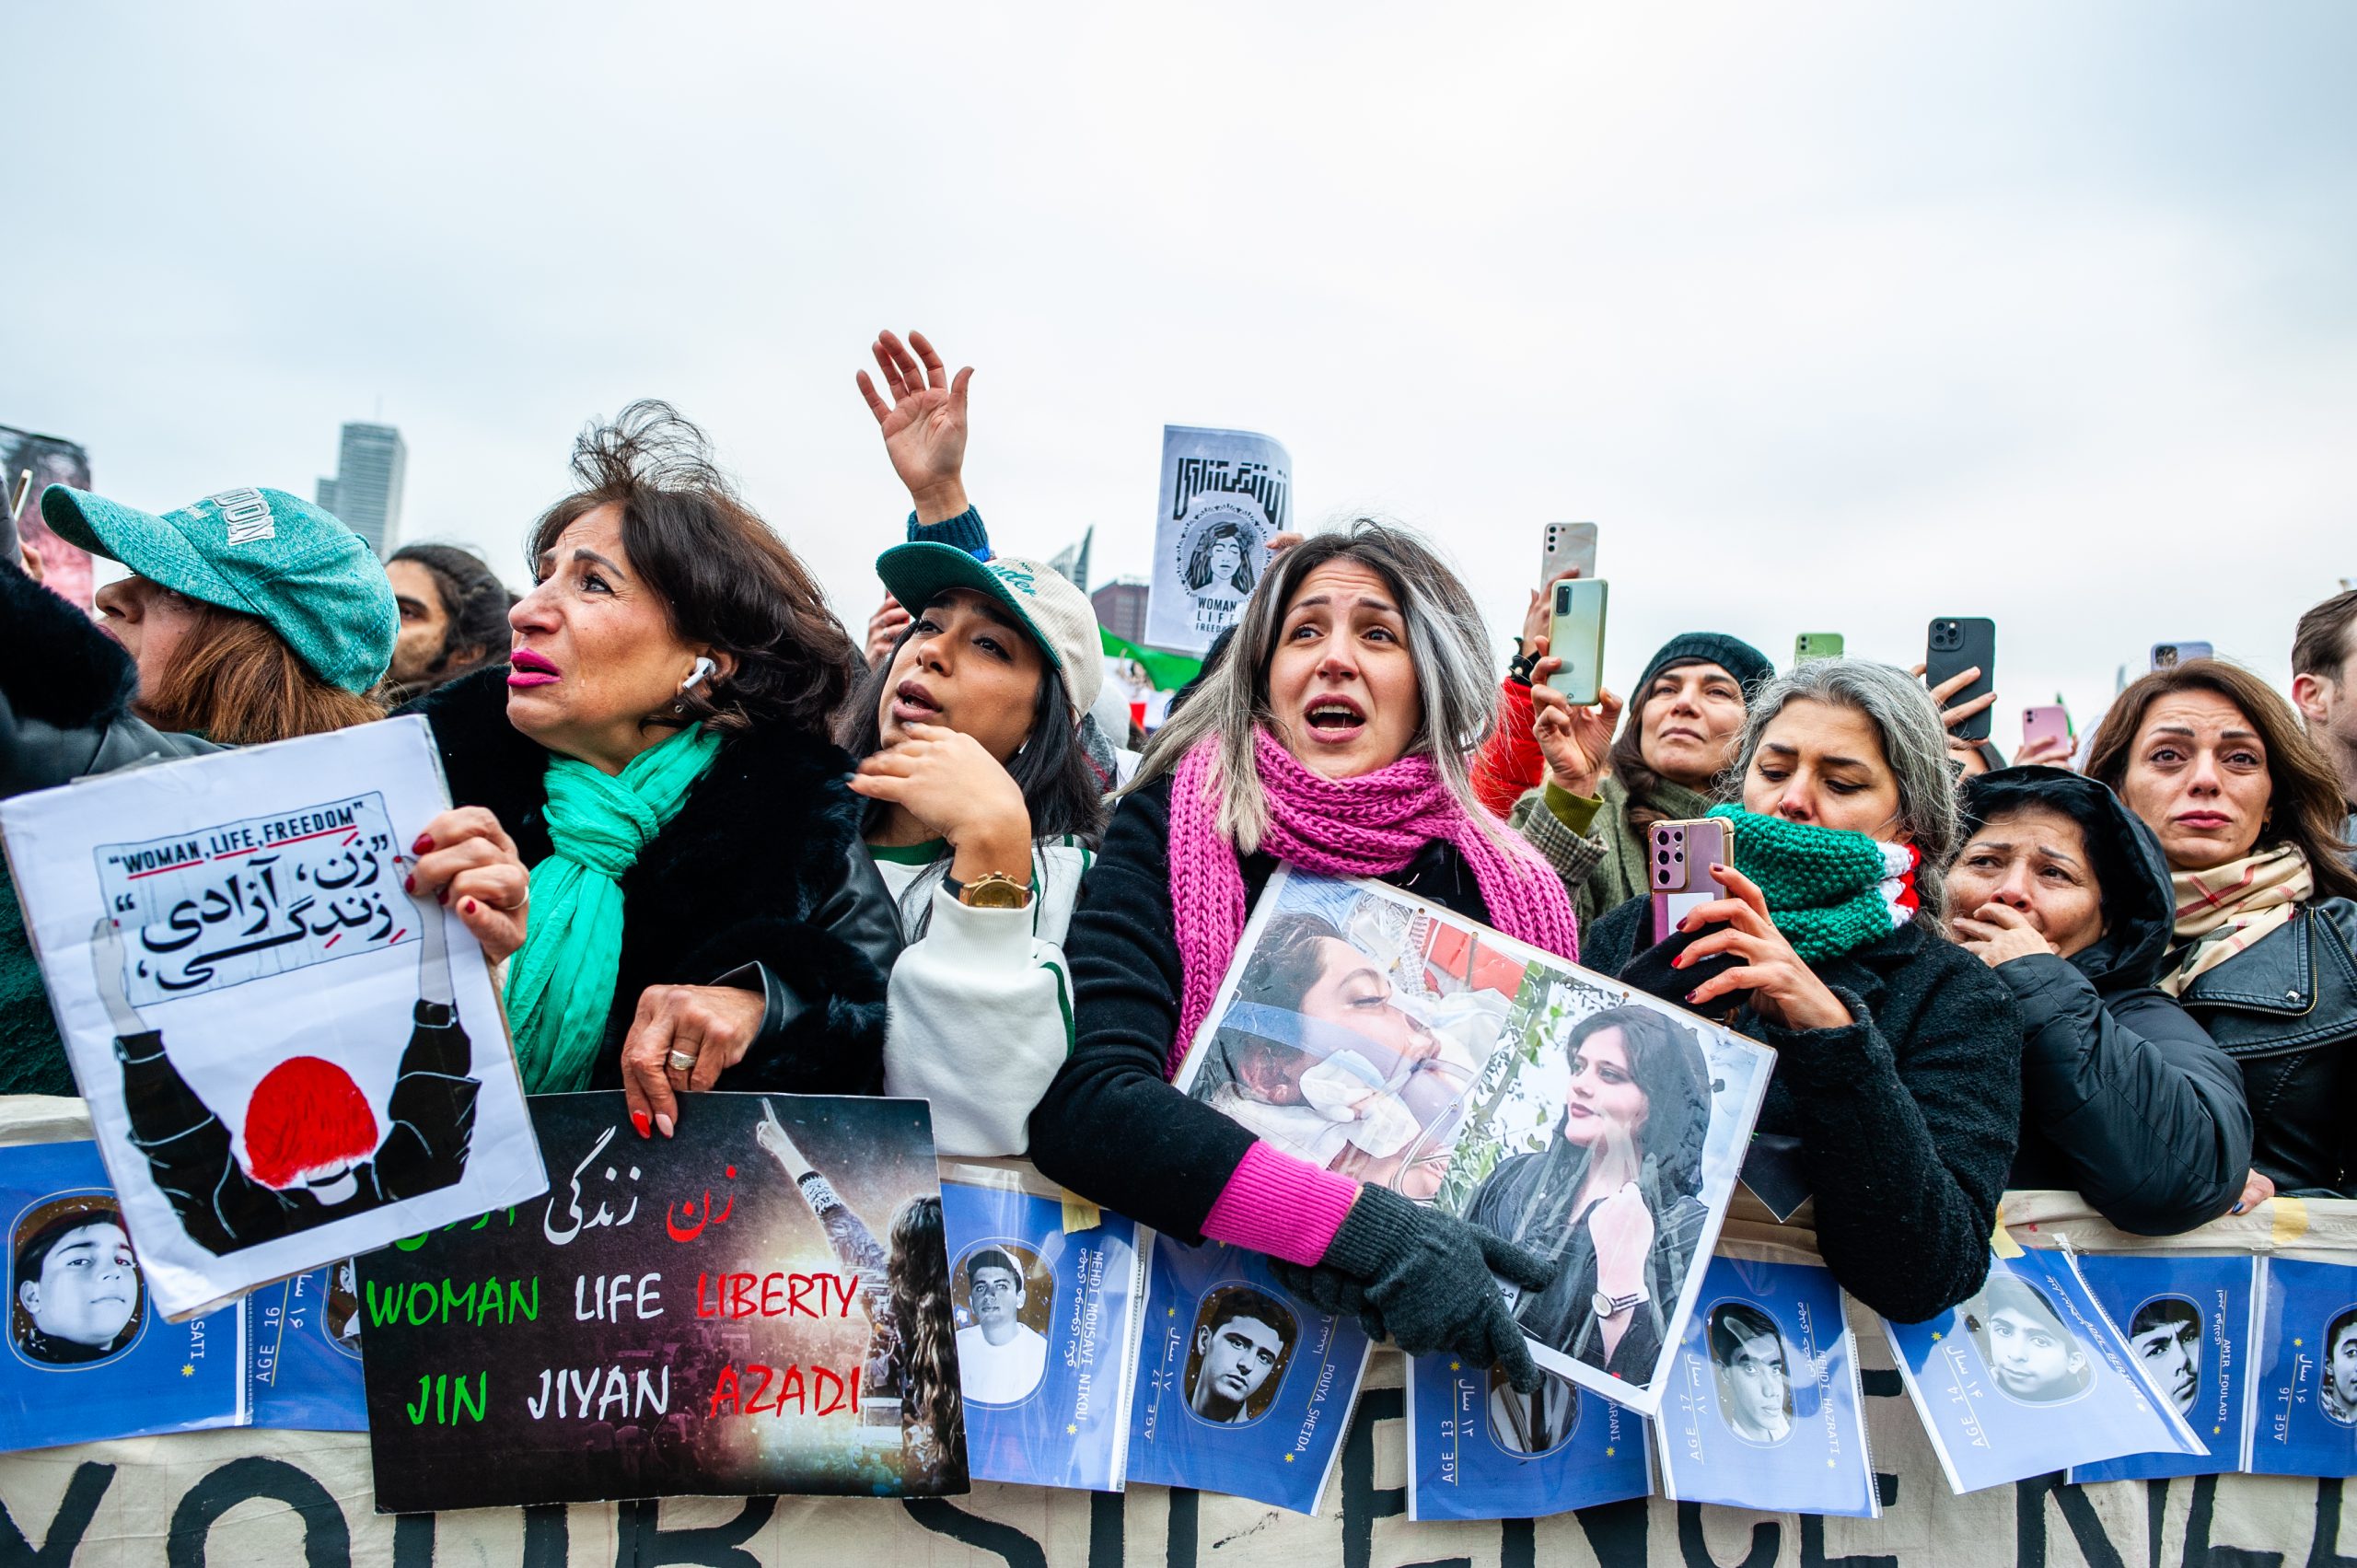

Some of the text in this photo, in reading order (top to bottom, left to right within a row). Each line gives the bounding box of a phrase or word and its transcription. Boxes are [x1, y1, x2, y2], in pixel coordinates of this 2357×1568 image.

[1196, 622, 1226, 633] FREEDO
[1197, 610, 1235, 623] LIFE
[1198, 597, 1237, 612] WOMAN
[539, 1125, 642, 1246] زندگی
[666, 1165, 737, 1243] زن
[295, 1274, 313, 1297] سا
[366, 1272, 859, 1328] WOMAN LIFE LIBERTY
[1063, 1248, 1089, 1368] مهدی موسوی نیکو
[255, 1307, 280, 1382] AGE 16
[1075, 1250, 1104, 1421] MEHDI MOUSAVI NIKOU
[1167, 1327, 1180, 1362] سال
[1797, 1302, 1809, 1334] مهدی
[2084, 1320, 2107, 1347] ADEL
[1687, 1353, 1701, 1387] سال
[1945, 1345, 1968, 1375] سال
[2218, 1339, 2231, 1422] AMIR FOULADI
[2299, 1353, 2313, 1381] سال
[406, 1365, 862, 1426] JIN JIYAN AZADI
[1144, 1369, 1161, 1439] AGE 17
[1295, 1364, 1335, 1452] POUYA SHEIDA
[1458, 1378, 1475, 1411] سال
[1608, 1400, 1620, 1442] ARANI
[1817, 1350, 1840, 1455] MEHDI HAZRATI
[1947, 1386, 1985, 1446] AGE 14
[2274, 1387, 2290, 1441] AGE 16
[1441, 1421, 1454, 1482] AGE 13
[1679, 1394, 1700, 1460] AGE 17
